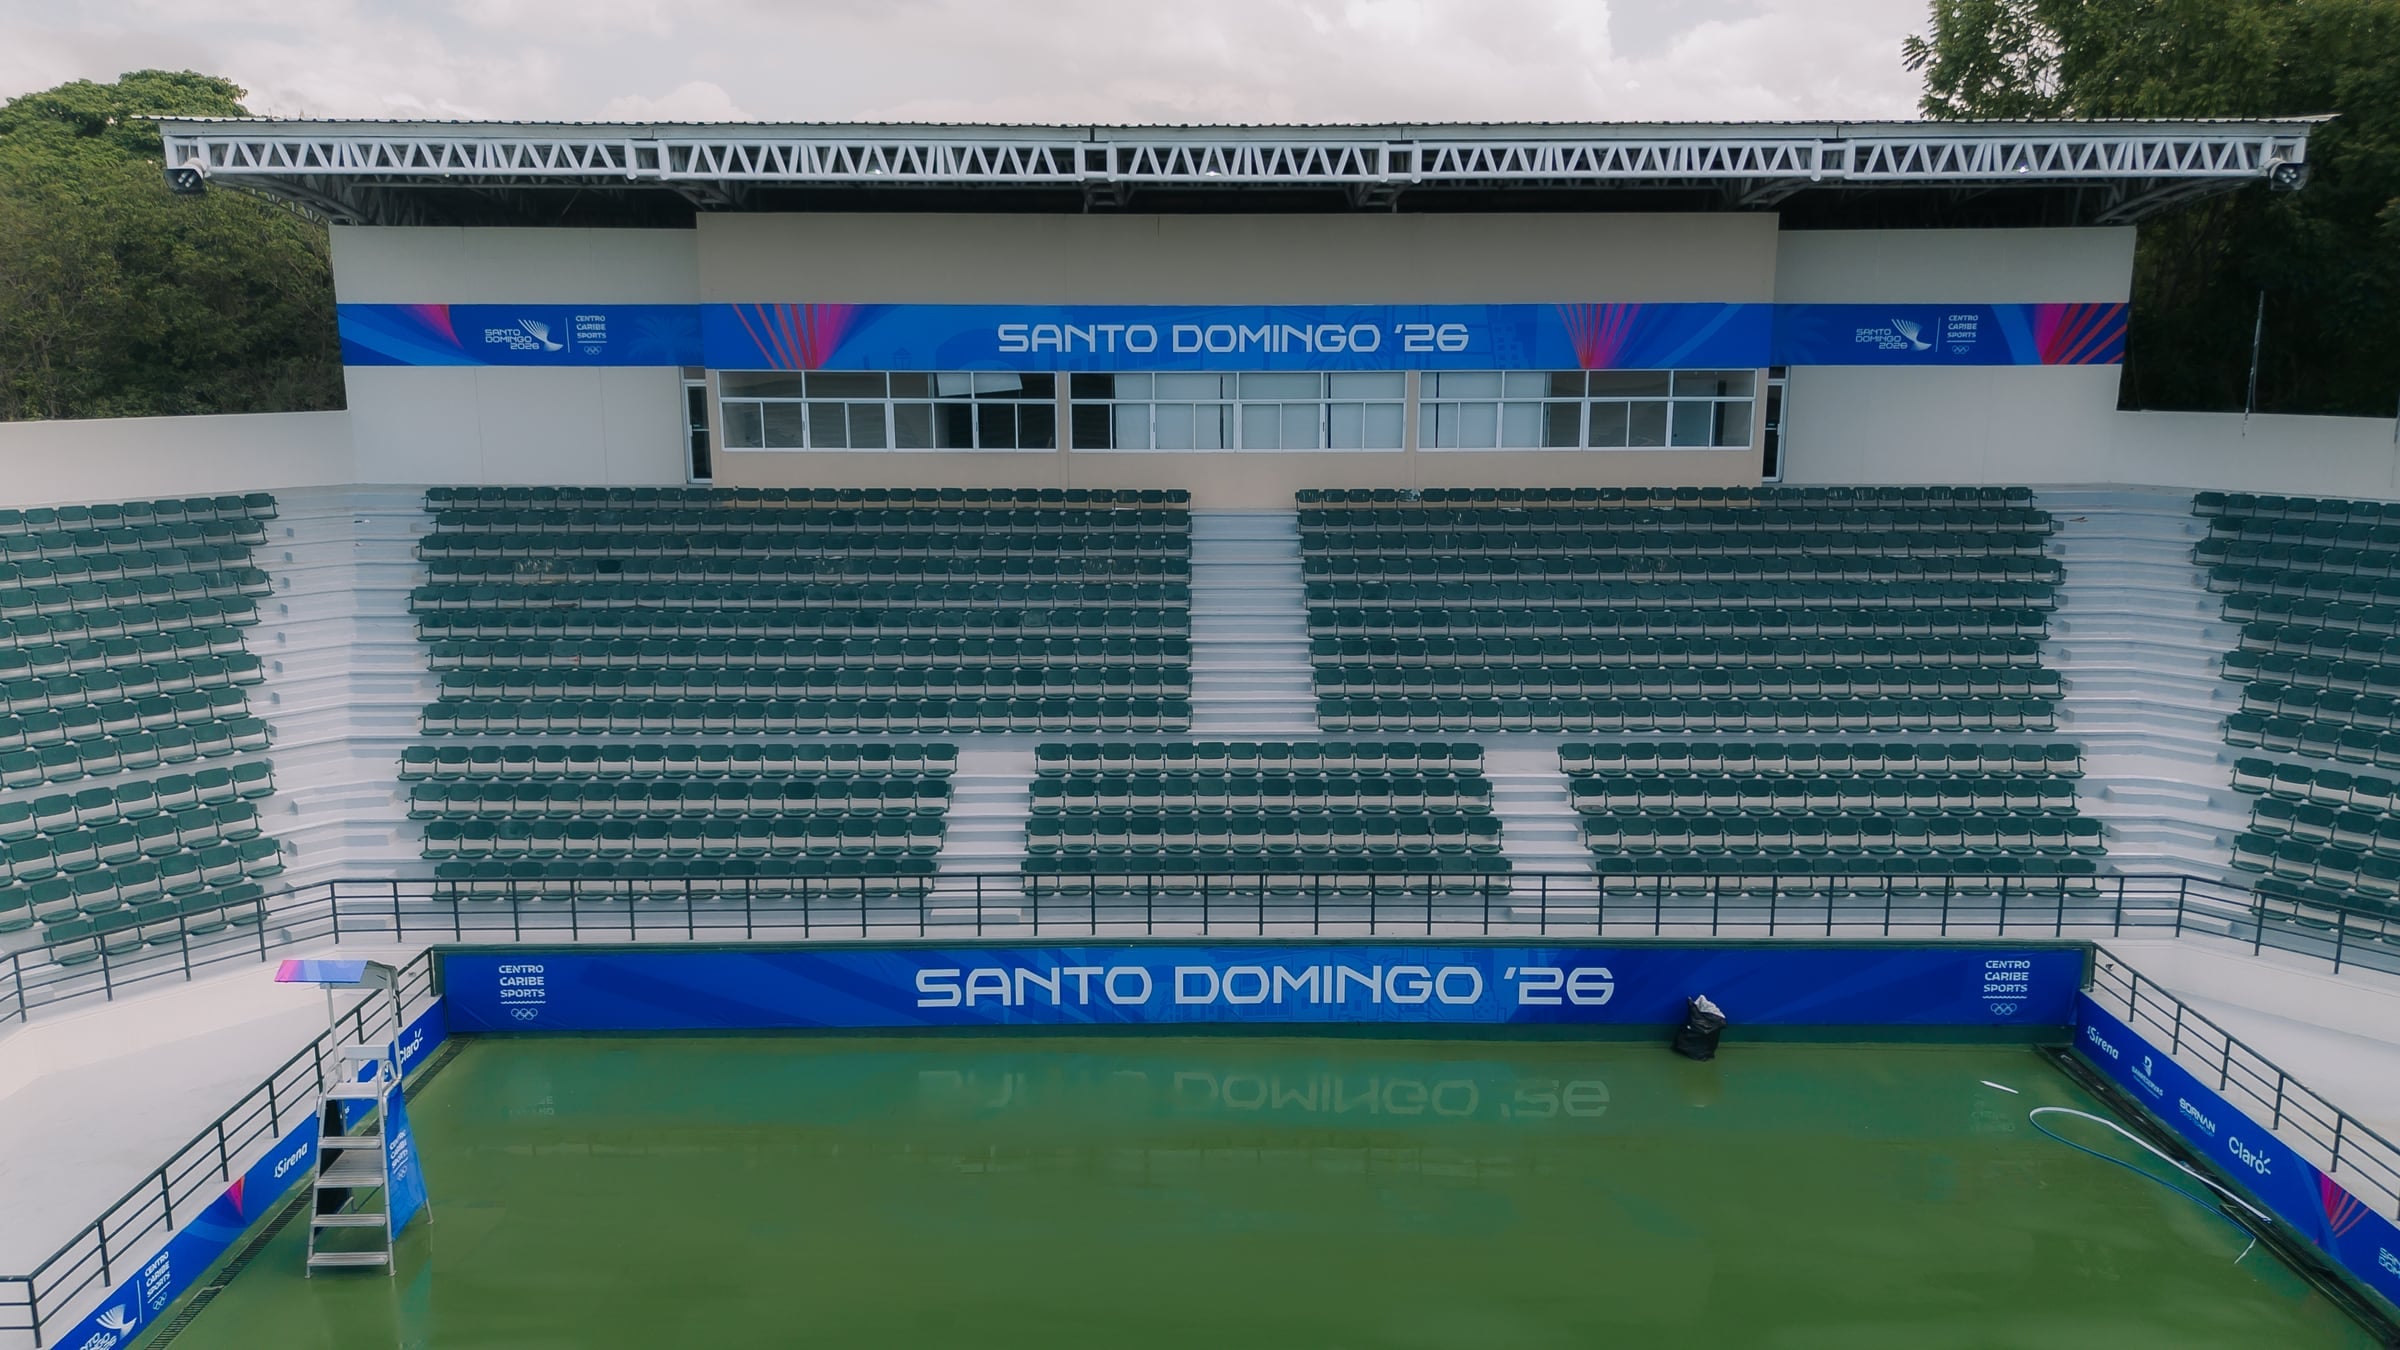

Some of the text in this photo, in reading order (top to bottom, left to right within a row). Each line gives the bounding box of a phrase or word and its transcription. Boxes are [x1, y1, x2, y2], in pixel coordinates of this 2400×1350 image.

[576, 323, 606, 331] CARIBE
[1947, 322, 1978, 330] CARIBE
[484, 328, 521, 336] SANTO
[1856, 328, 1892, 336] SANTO
[485, 335, 532, 343] DOMINGO
[998, 323, 1470, 353] SANTO DOMINGO '26
[1855, 335, 1902, 343] DOMINGO
[510, 342, 540, 350] 2026
[498, 964, 544, 974] CENTRO
[1985, 960, 2031, 969] CENTRO
[499, 976, 545, 986] CARIBE
[1984, 971, 2029, 981] CARIBE
[916, 965, 1615, 1007] SANTO DOMINGO '26
[1983, 983, 2028, 993] SPORTS
[499, 988, 546, 998] SPORTS
[2179, 1097, 2216, 1134] BORNAN
[2228, 1136, 2267, 1175] Claro
[144, 1251, 169, 1277] CENTRO
